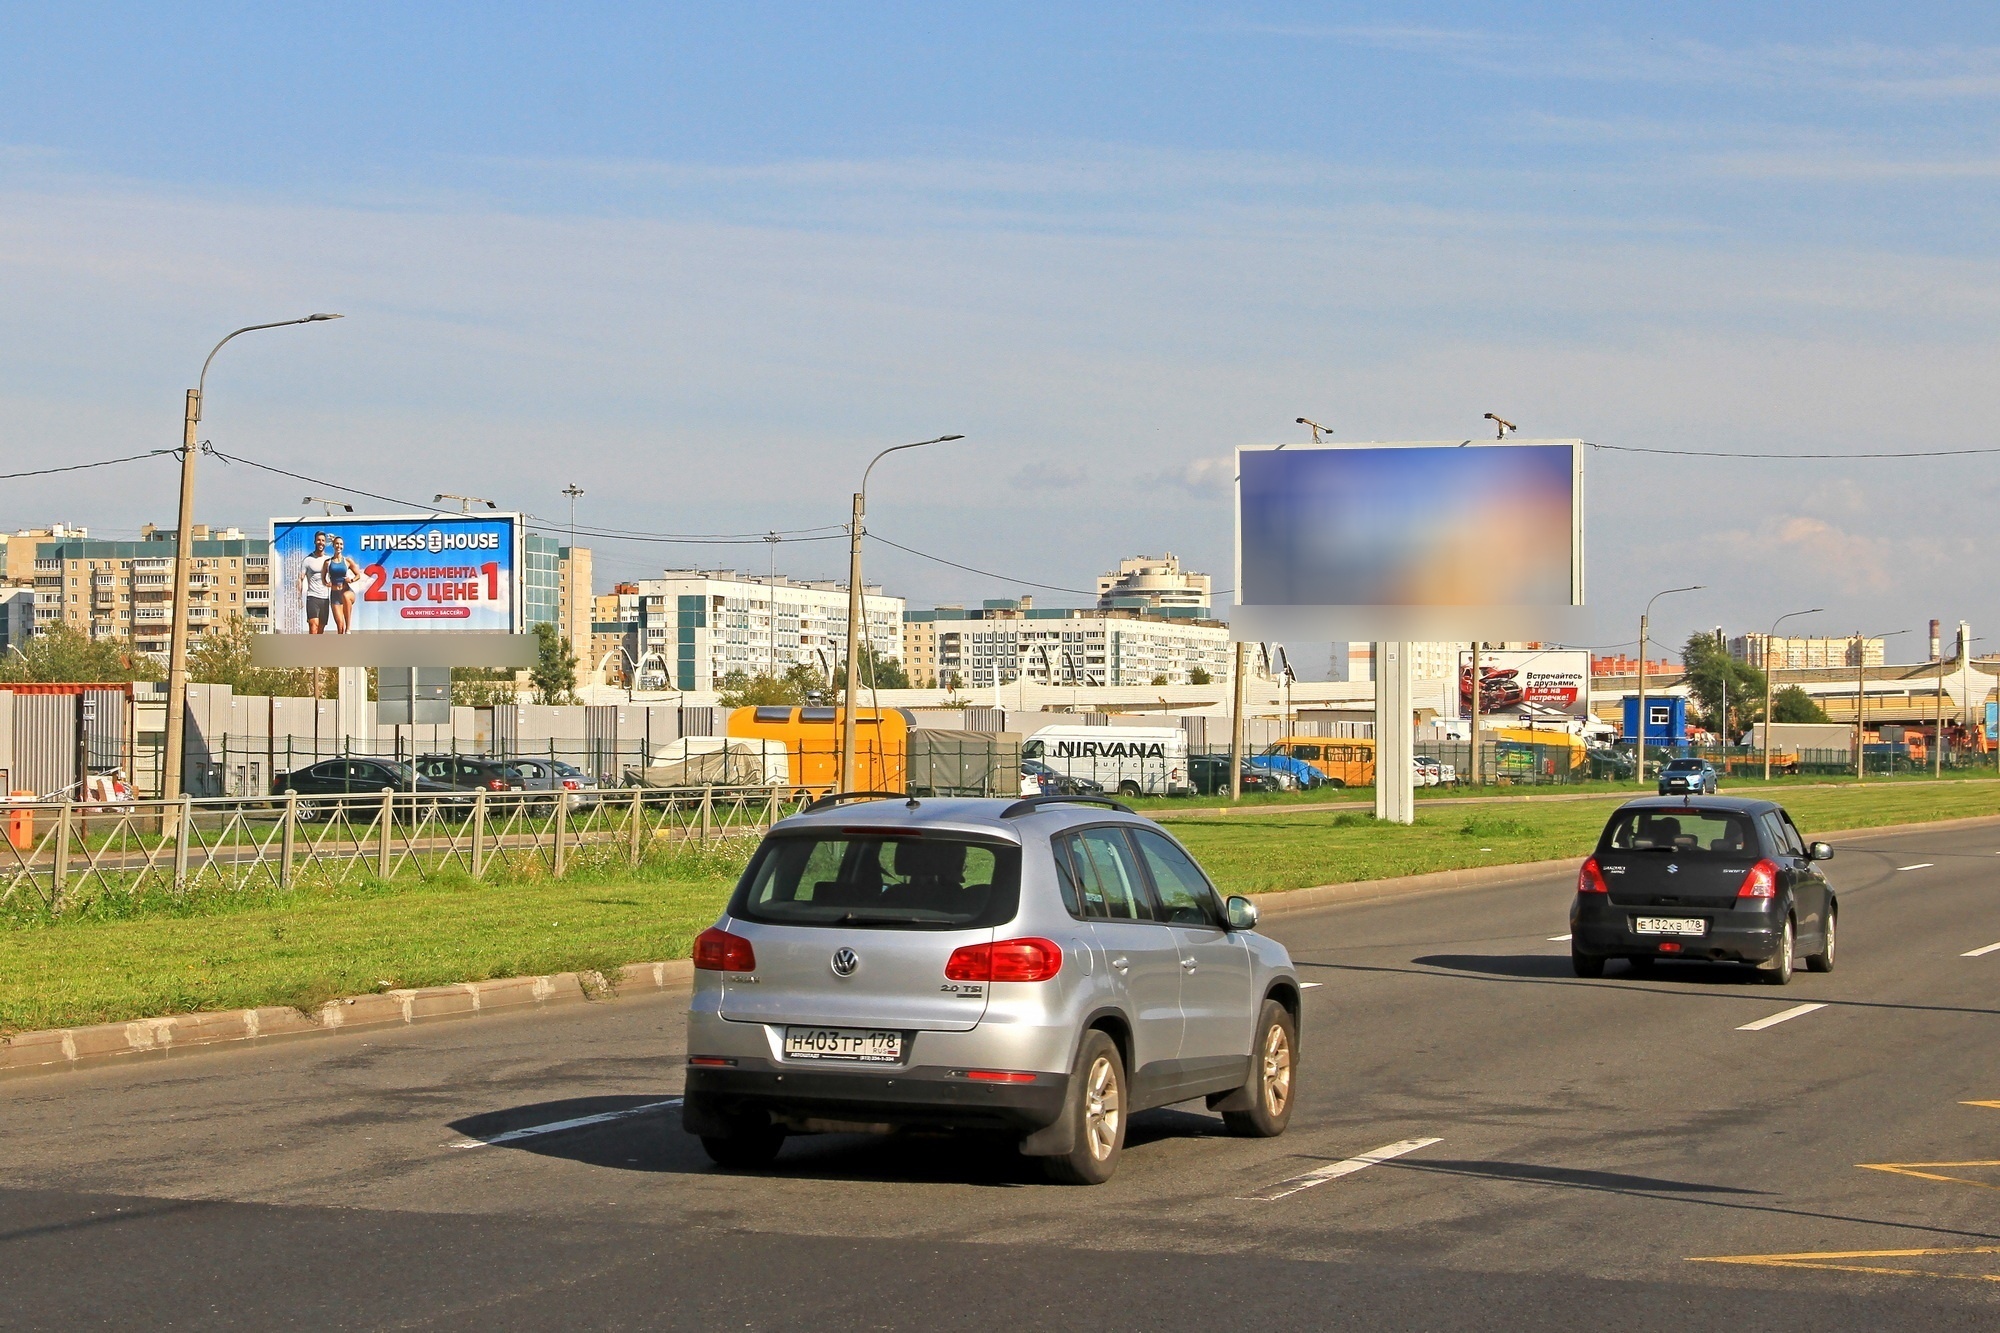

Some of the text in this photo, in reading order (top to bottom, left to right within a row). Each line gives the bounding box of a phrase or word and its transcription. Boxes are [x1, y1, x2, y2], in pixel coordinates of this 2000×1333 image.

[360, 533, 499, 550] FITNESS HOUSE
[392, 567, 478, 579] АБОНЕМЕНТА
[363, 563, 388, 601] 2
[392, 582, 479, 604] ПО ЦЕНЕ
[1526, 672, 1583, 680] Встречайтесь
[1058, 741, 1164, 758] NIRVANA
[963, 985, 983, 993] TSI
